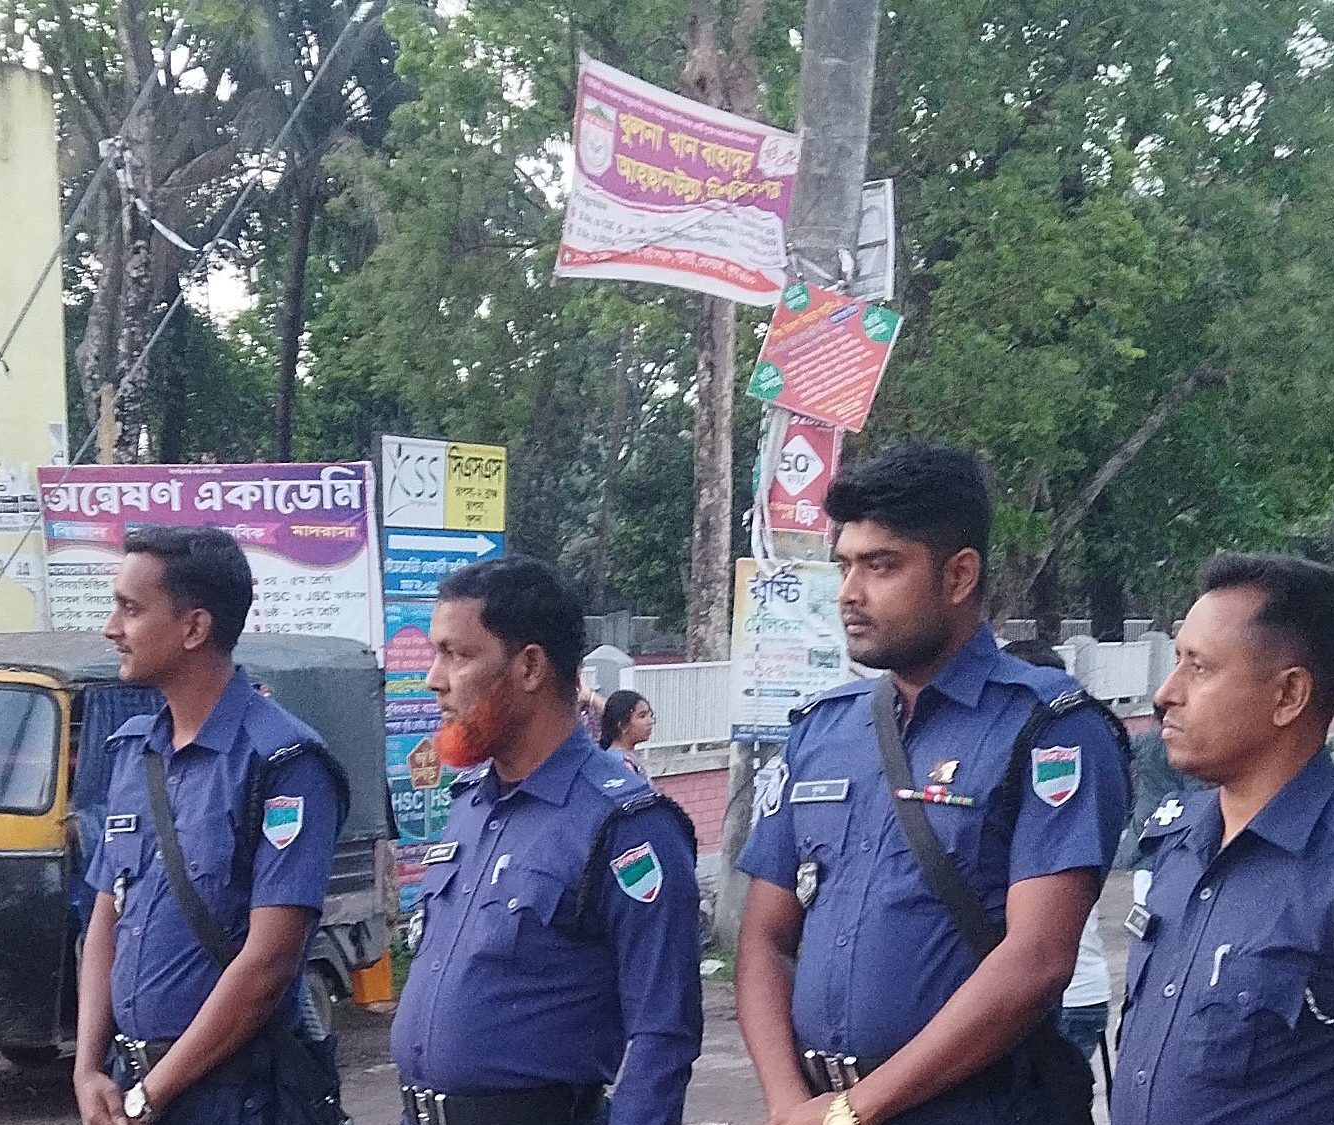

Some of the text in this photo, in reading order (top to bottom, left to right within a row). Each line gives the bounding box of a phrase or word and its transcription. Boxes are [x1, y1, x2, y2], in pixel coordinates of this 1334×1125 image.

[41, 478, 183, 517] অন্বেষণ
[194, 466, 362, 514] একাডেমি
[263, 591, 290, 602] PSC
[392, 789, 452, 810] HSC HS
